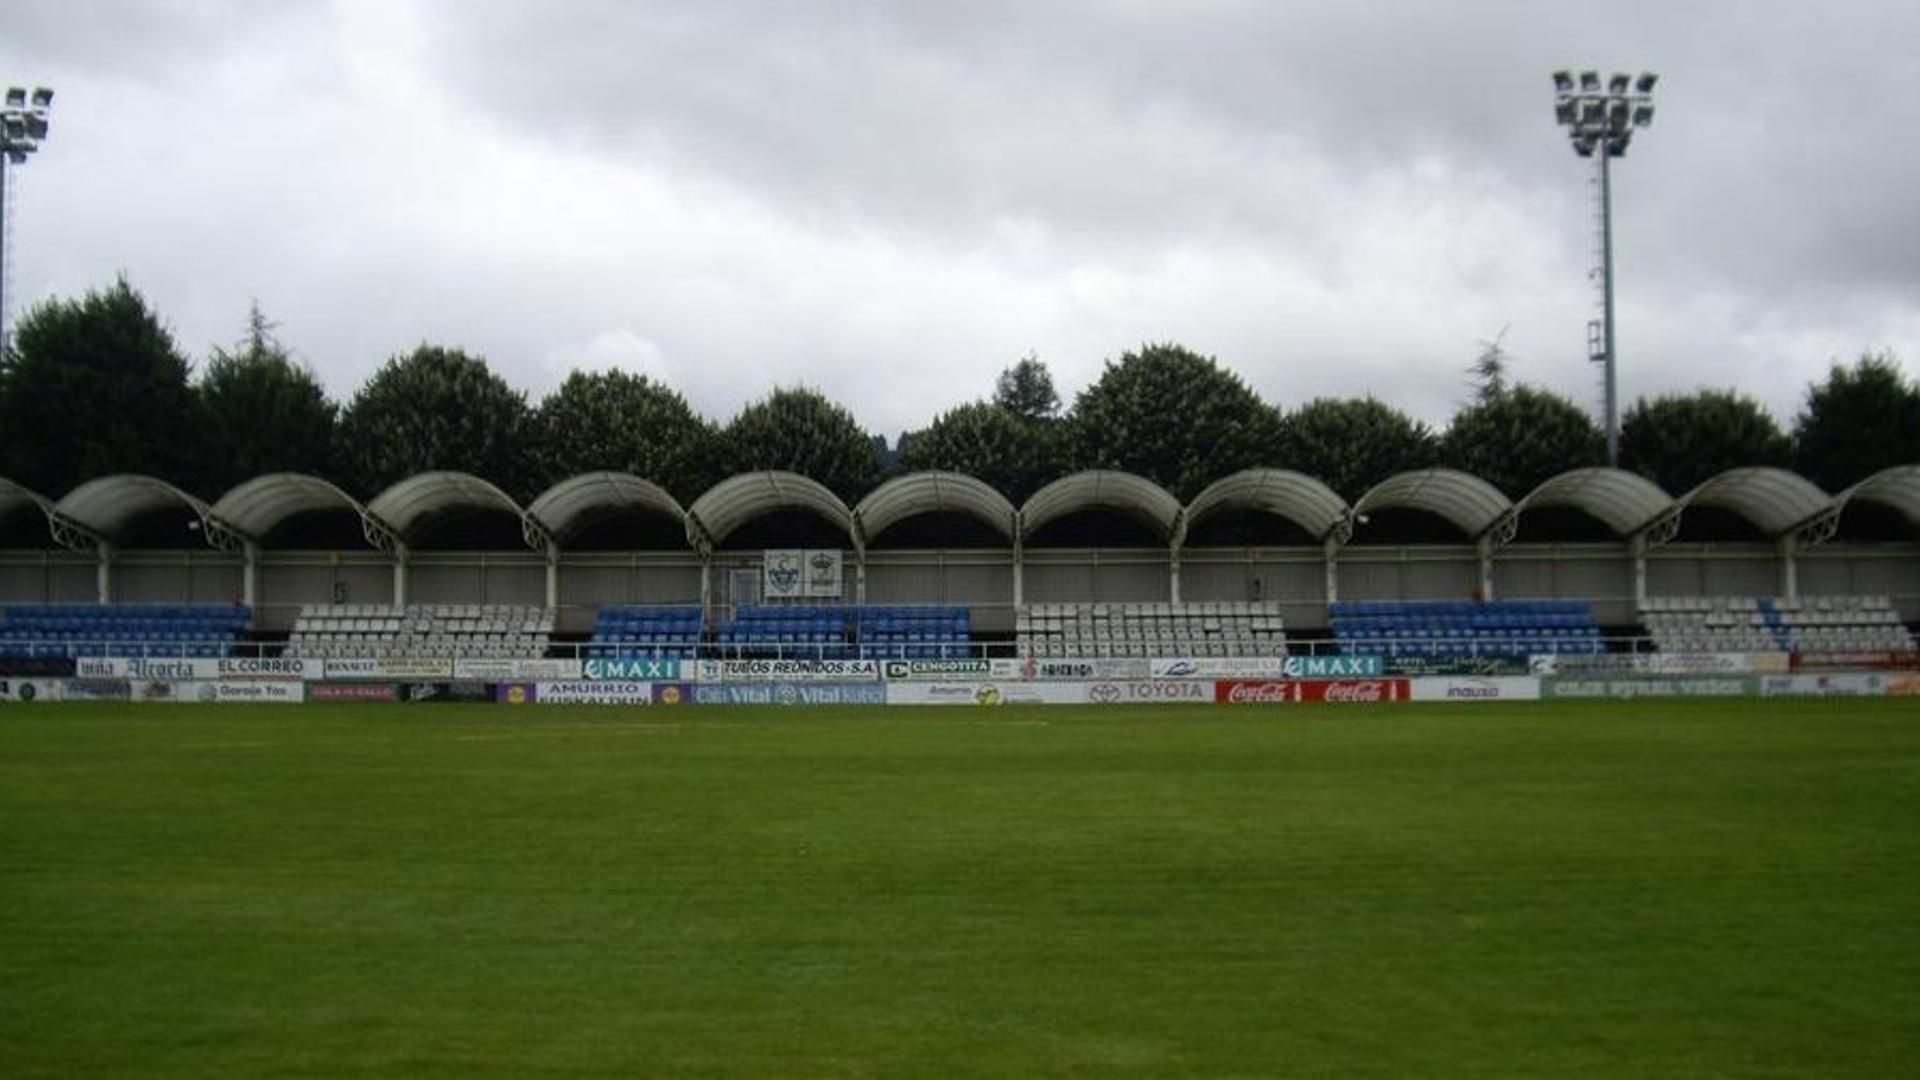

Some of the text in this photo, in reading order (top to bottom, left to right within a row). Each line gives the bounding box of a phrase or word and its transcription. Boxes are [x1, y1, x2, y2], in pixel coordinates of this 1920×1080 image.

[238, 660, 303, 672] CORREO
[607, 661, 673, 677] MAXI
[1307, 658, 1375, 674] MAXI
[549, 683, 639, 693] AMURRIO
[1128, 683, 1203, 697] TOYOTA
